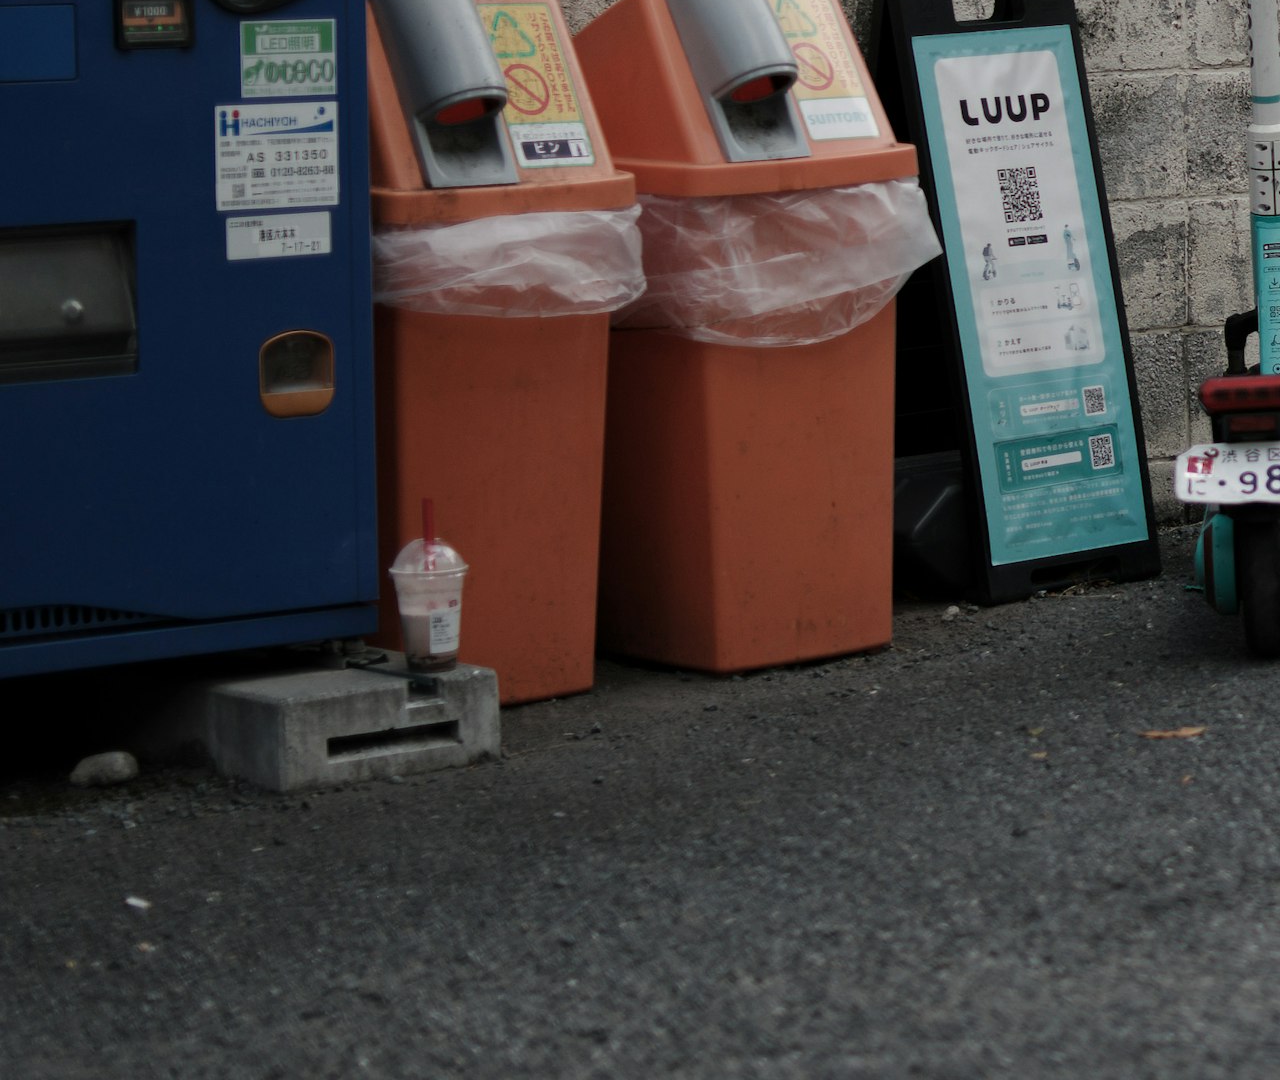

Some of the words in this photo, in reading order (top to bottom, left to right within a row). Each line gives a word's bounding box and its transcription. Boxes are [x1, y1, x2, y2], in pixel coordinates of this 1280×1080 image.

[960, 92, 1050, 127] LUUP
[534, 142, 560, 154] ビン
[246, 152, 265, 163] AS
[275, 149, 328, 162] 331350
[996, 297, 1016, 306] かりる
[1004, 337, 1022, 346] かえす
[1187, 478, 1206, 496] に
